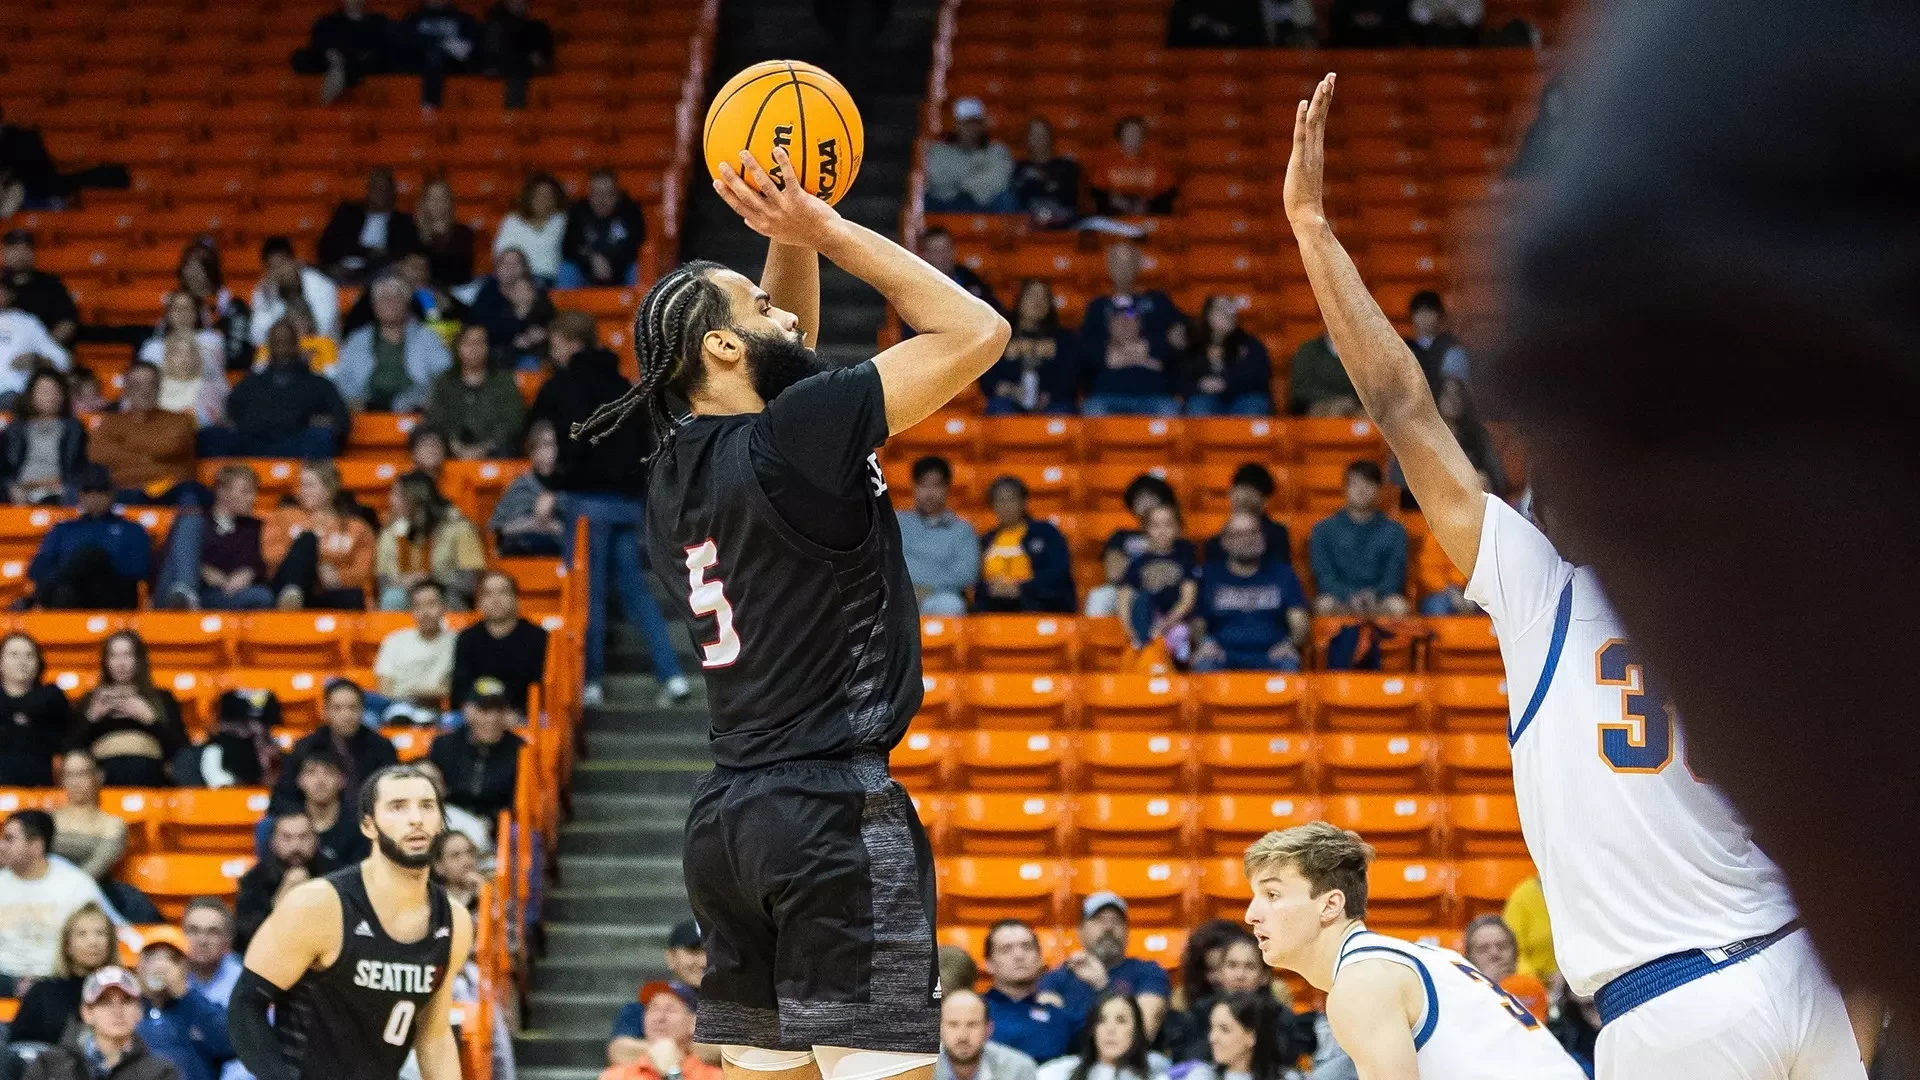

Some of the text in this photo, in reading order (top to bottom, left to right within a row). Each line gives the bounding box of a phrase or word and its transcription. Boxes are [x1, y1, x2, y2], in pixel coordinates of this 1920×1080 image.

[684, 537, 740, 668] 5
[1594, 638, 1702, 783] 3
[353, 959, 436, 993] SEATTLE
[383, 1000, 415, 1046] 0
